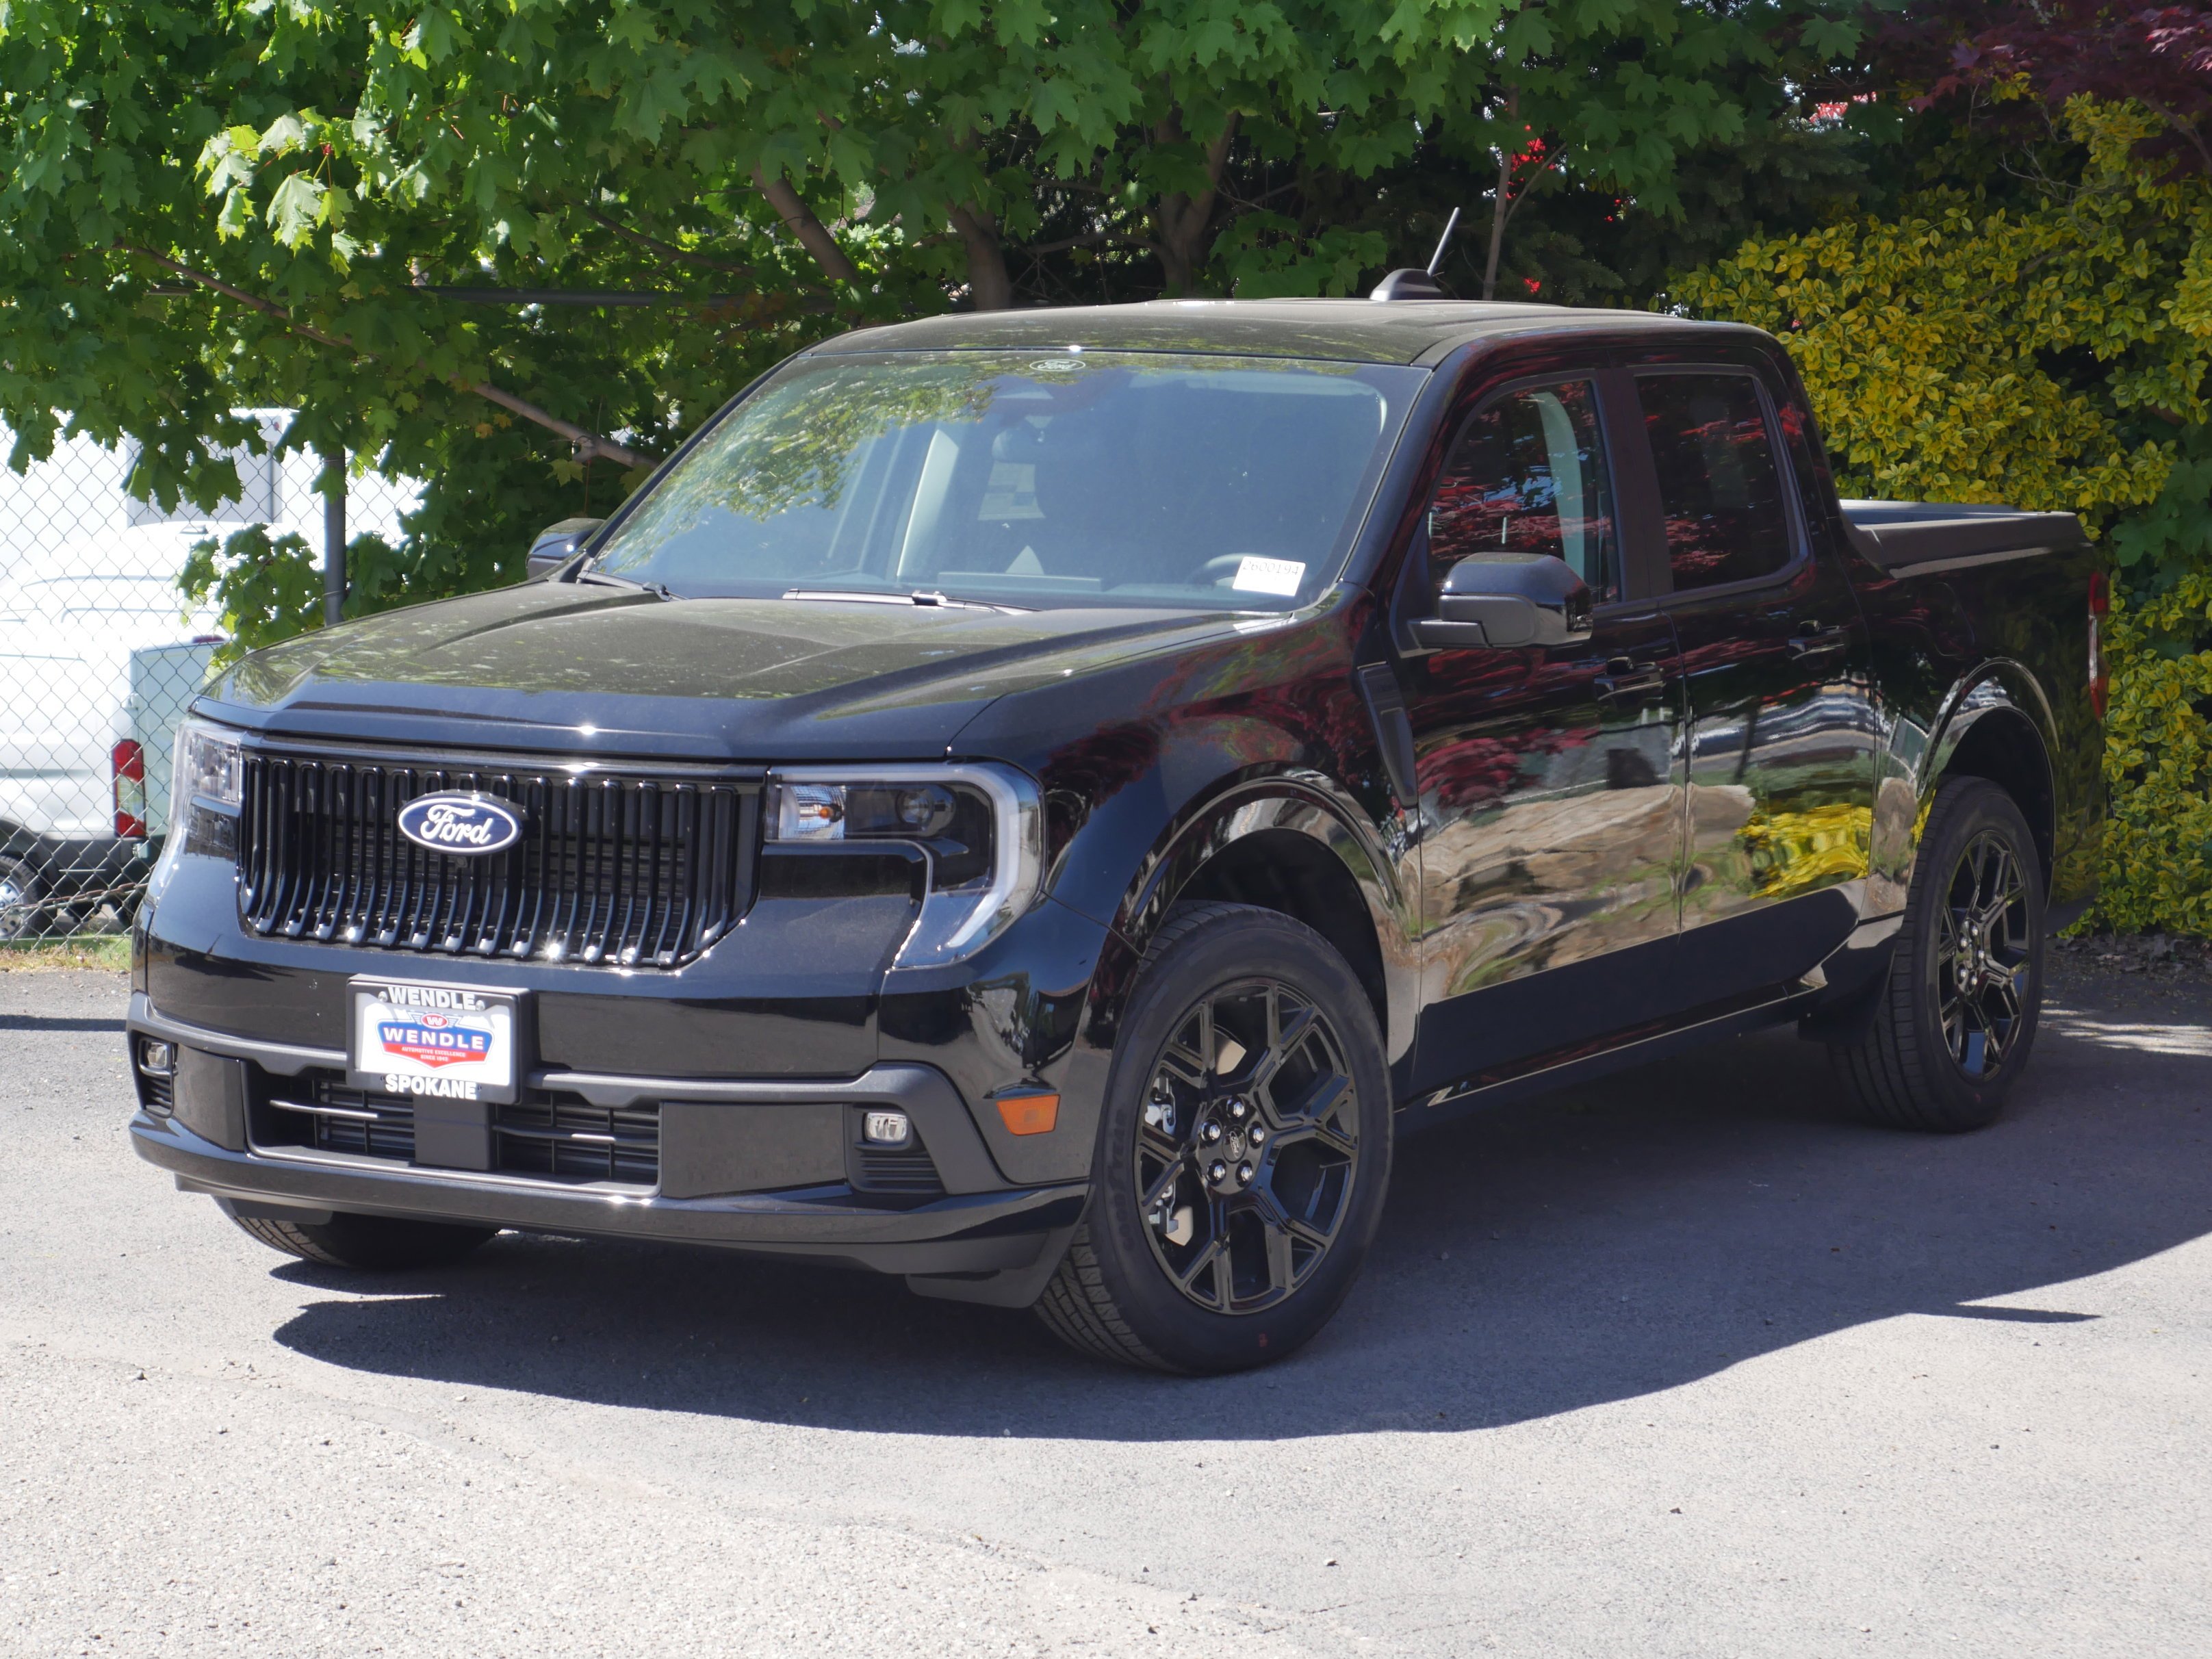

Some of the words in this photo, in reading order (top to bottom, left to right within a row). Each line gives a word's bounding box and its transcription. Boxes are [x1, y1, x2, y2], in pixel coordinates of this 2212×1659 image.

[1038, 361, 1077, 370] Ford
[420, 804, 494, 845] Ford
[387, 986, 476, 1011] WENDLE
[426, 1016, 443, 1026] W
[383, 1027, 484, 1050] WENDLE
[401, 1046, 434, 1055] AUTOMOTIVE
[434, 1049, 466, 1057] EXCELLENCE
[385, 1073, 477, 1100] SPOKANE
